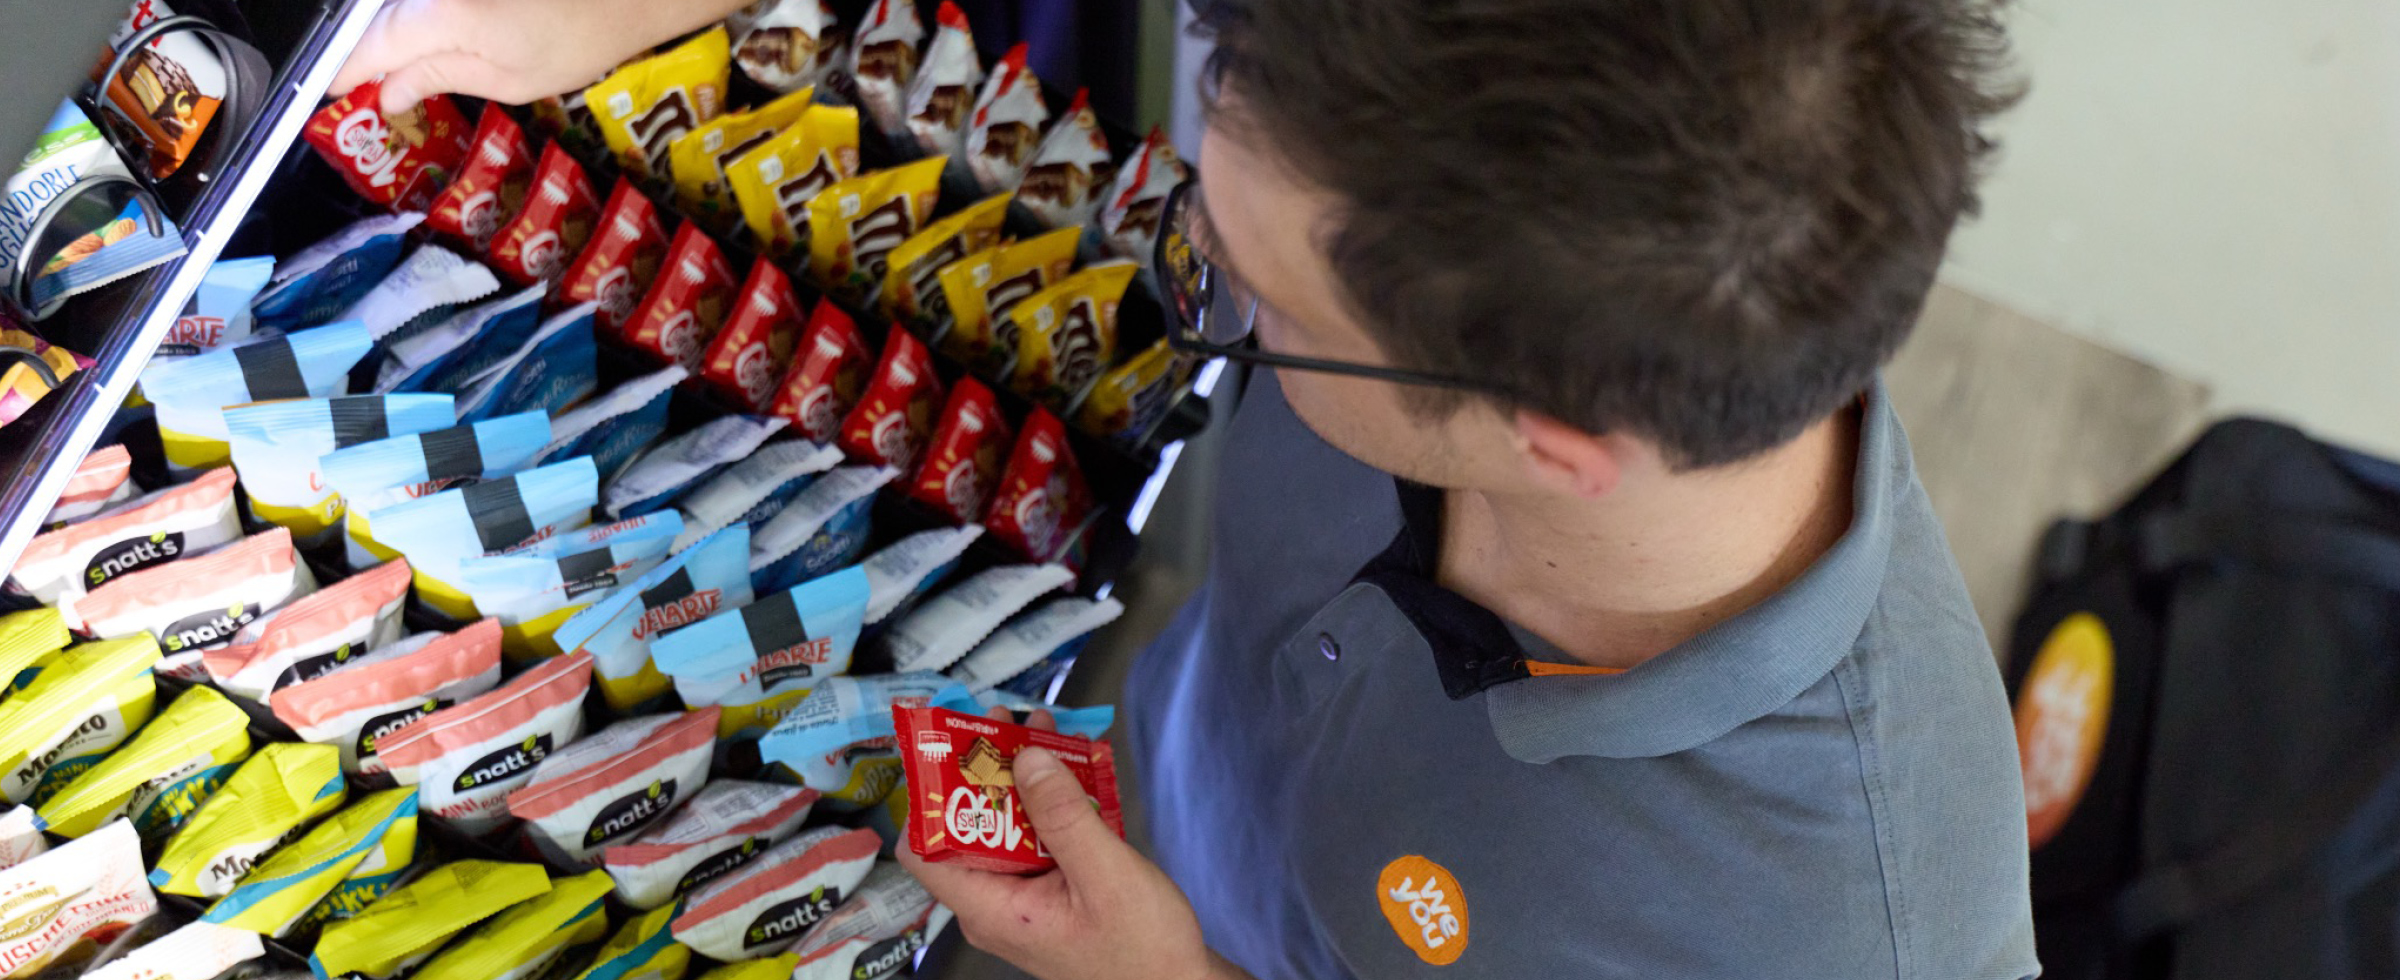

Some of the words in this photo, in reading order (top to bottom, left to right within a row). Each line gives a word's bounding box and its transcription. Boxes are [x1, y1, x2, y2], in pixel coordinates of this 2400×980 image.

[163, 316, 225, 347] ARTE
[460, 745, 546, 788] snatt's
[945, 787, 1023, 852] 100
[957, 809, 995, 832] YEARS
[1389, 876, 1446, 949] you
[1420, 876, 1460, 940] we
